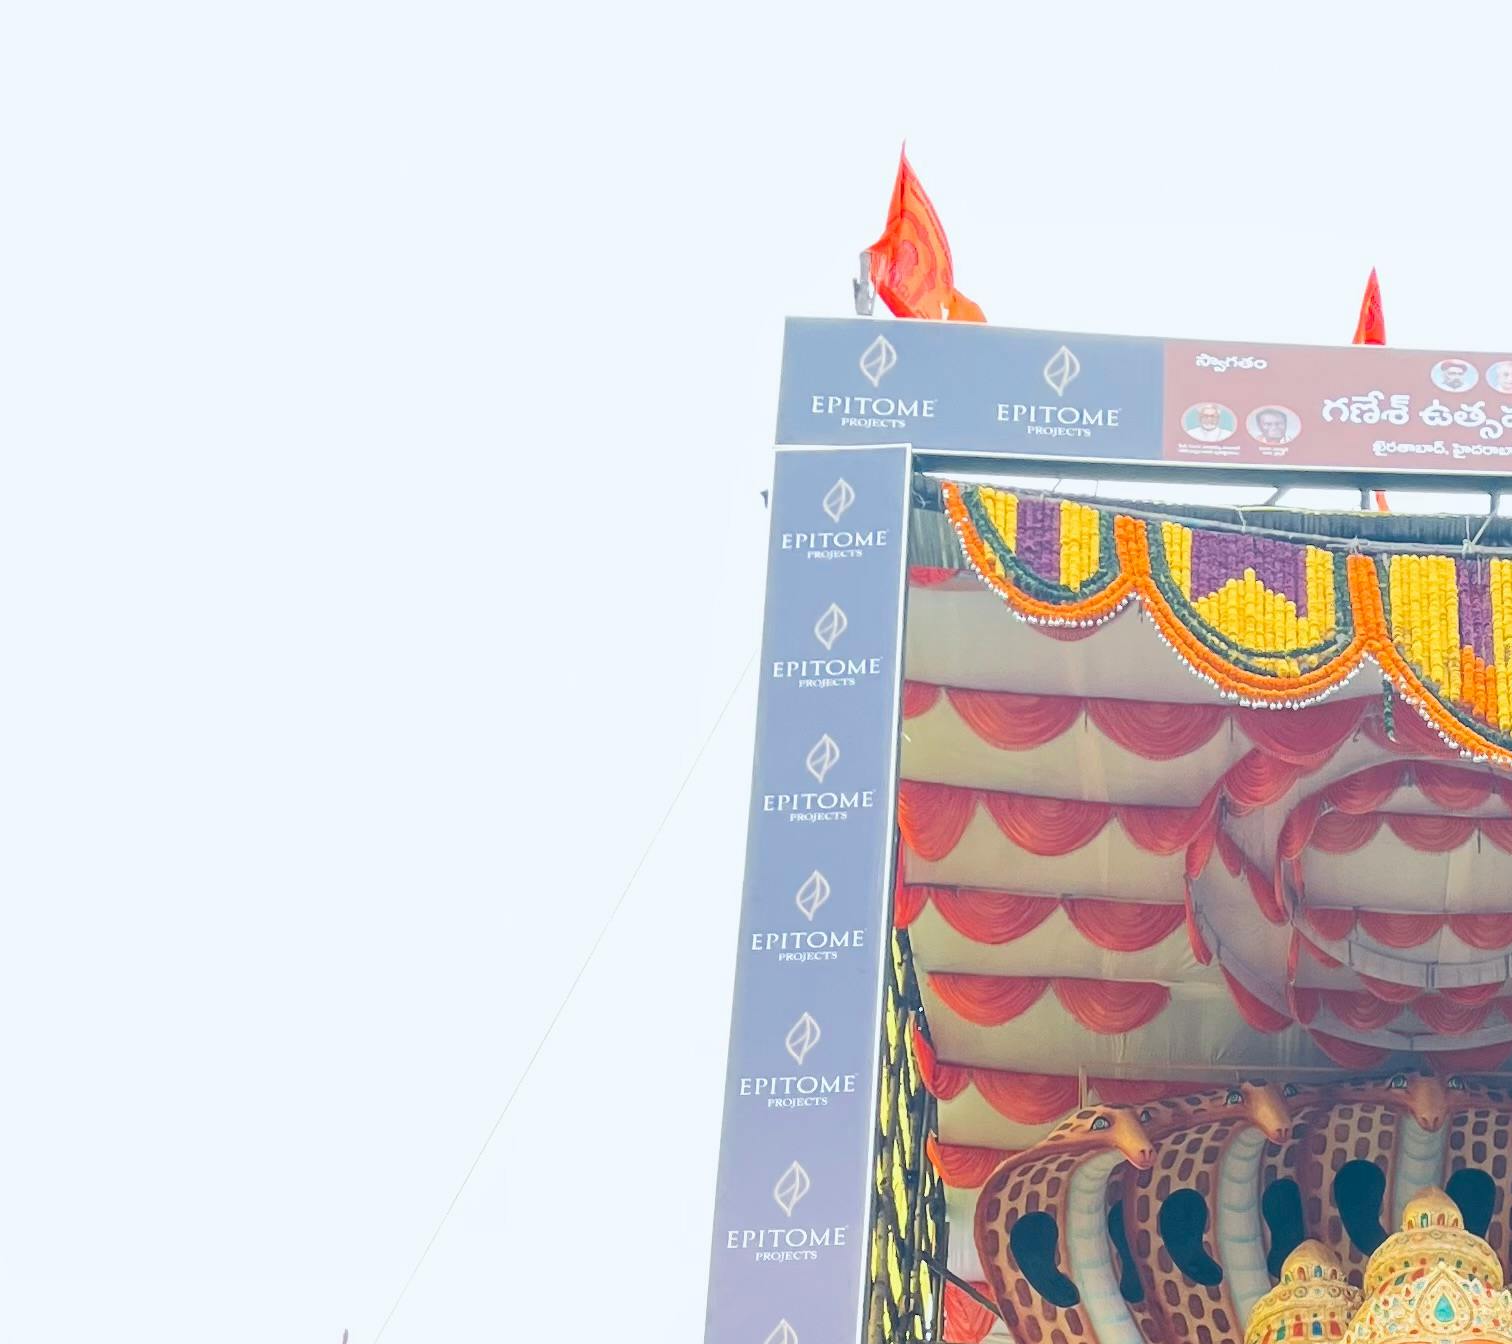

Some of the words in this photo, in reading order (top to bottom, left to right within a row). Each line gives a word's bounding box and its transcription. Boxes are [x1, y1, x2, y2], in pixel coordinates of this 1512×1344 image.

[812, 396, 933, 417] EPITOME
[998, 404, 1118, 426] EPITOME
[842, 418, 906, 430] PROJECTS
[1028, 428, 1091, 438] PROJECTS
[783, 531, 886, 548] EPITOME
[808, 549, 862, 560] PROJECTS
[764, 792, 873, 811] EPITOME
[790, 811, 847, 822] PROJECTS
